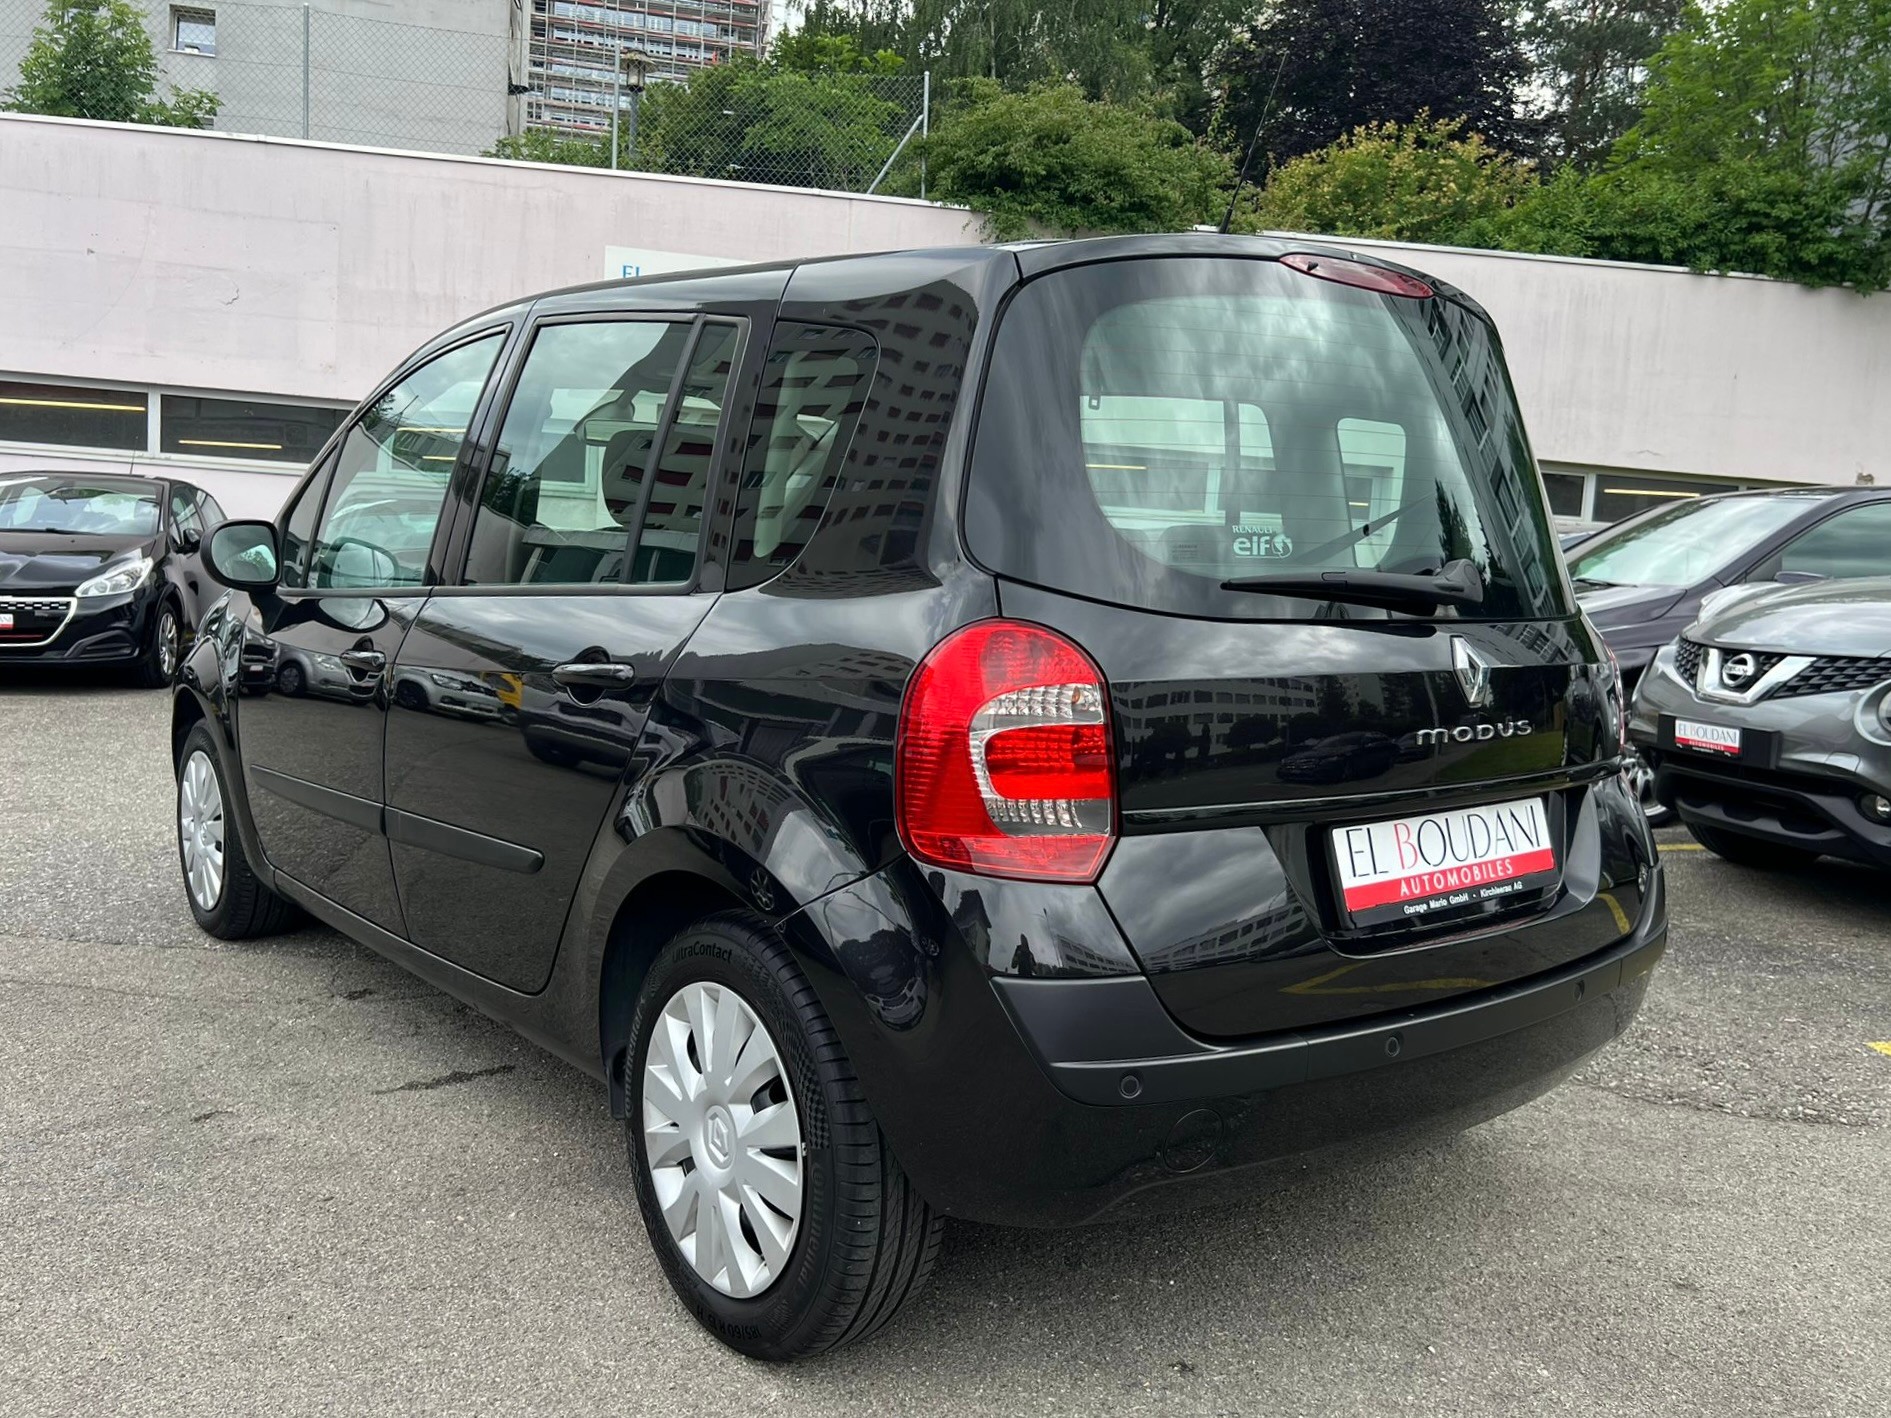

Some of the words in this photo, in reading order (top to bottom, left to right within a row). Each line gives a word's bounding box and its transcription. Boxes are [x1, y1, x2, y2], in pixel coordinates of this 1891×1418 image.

[1233, 535, 1271, 556] elf
[1690, 725, 1737, 744] BOUDANI
[1346, 827, 1389, 878] EL
[1394, 805, 1541, 871] BOUDANI
[1400, 858, 1514, 897] AUTOMOBILES
[1403, 902, 1428, 915] Garage
[1429, 898, 1448, 909] Mario
[1449, 893, 1469, 905] GmbH
[1513, 881, 1523, 890] AG
